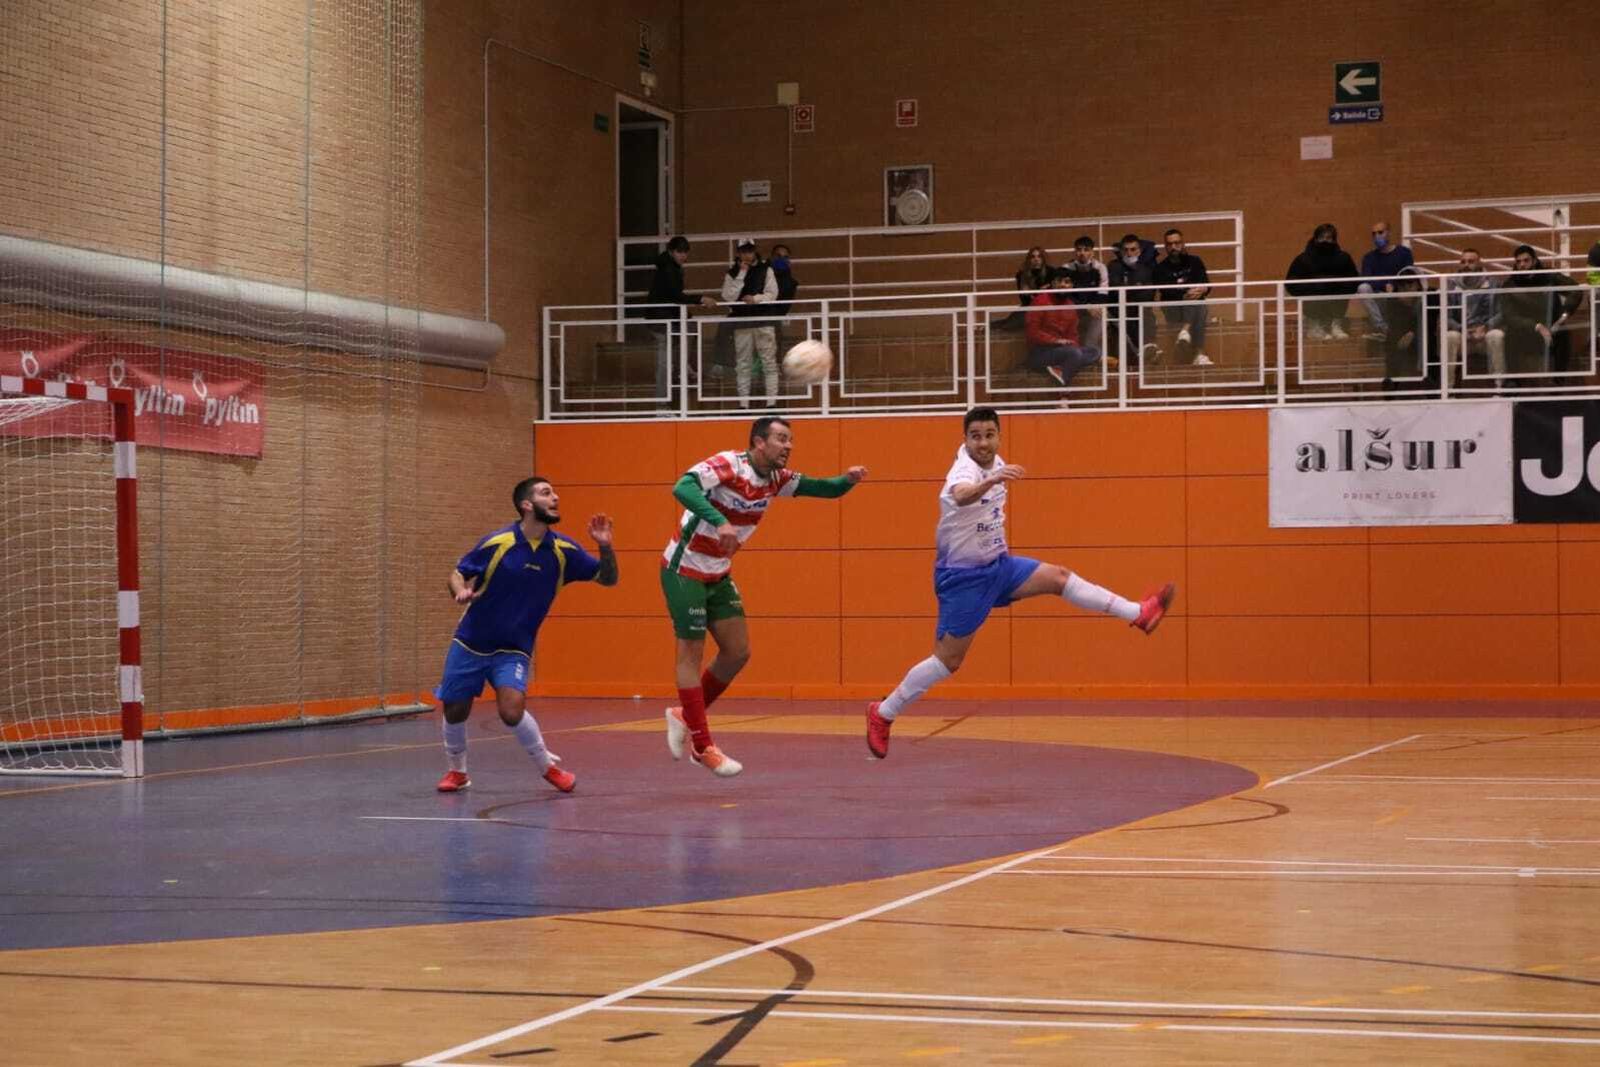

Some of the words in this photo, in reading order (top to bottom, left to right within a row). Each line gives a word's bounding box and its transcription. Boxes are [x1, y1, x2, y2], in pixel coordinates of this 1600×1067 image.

[134, 384, 185, 416] yltin
[1520, 416, 1600, 496] J
[1343, 491, 1381, 500] PRINT
[1387, 489, 1437, 500] LOVERS
